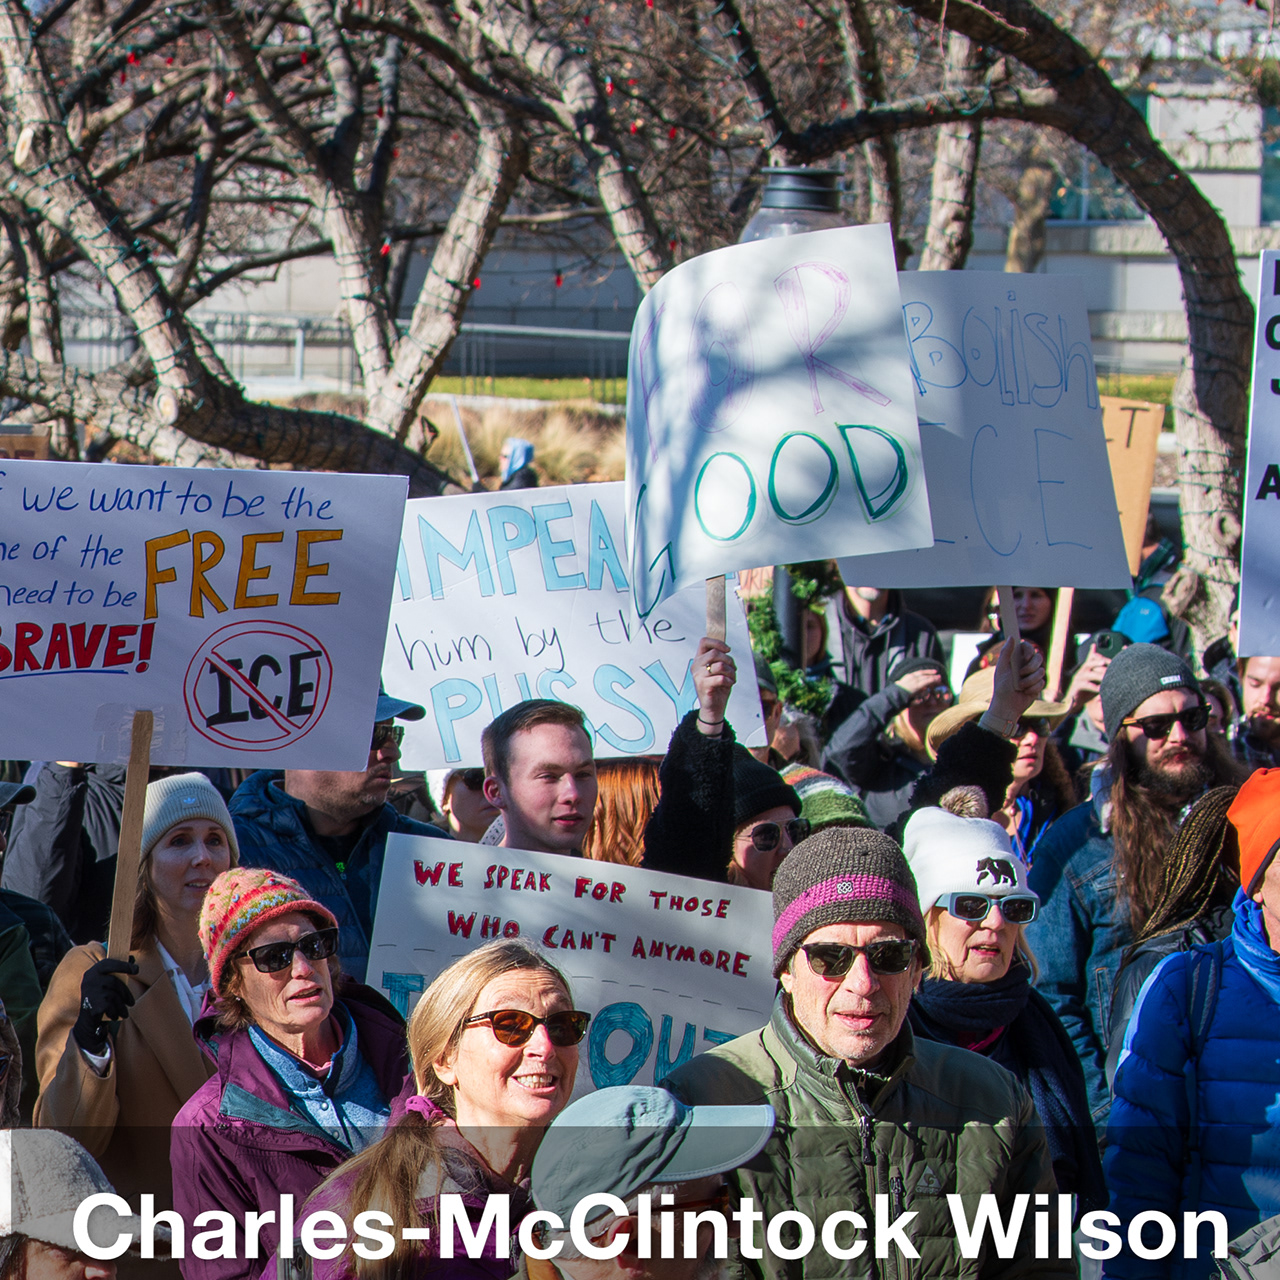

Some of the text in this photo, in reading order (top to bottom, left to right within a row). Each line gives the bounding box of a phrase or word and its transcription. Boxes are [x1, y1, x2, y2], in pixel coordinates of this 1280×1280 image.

[22, 485, 79, 512] we
[89, 480, 172, 513] want
[175, 480, 213, 515] to
[221, 480, 266, 519] be
[280, 485, 336, 521] the
[32, 534, 68, 562] of
[80, 534, 124, 568] the
[143, 529, 344, 620] FREE
[63, 579, 94, 608] to
[102, 579, 138, 608] be
[394, 610, 686, 673] him by the
[205, 650, 323, 728] ICE
[413, 859, 732, 919] WE SPEAK FOR THOSE
[447, 910, 753, 978] WHO CAN'T ANYMORE
